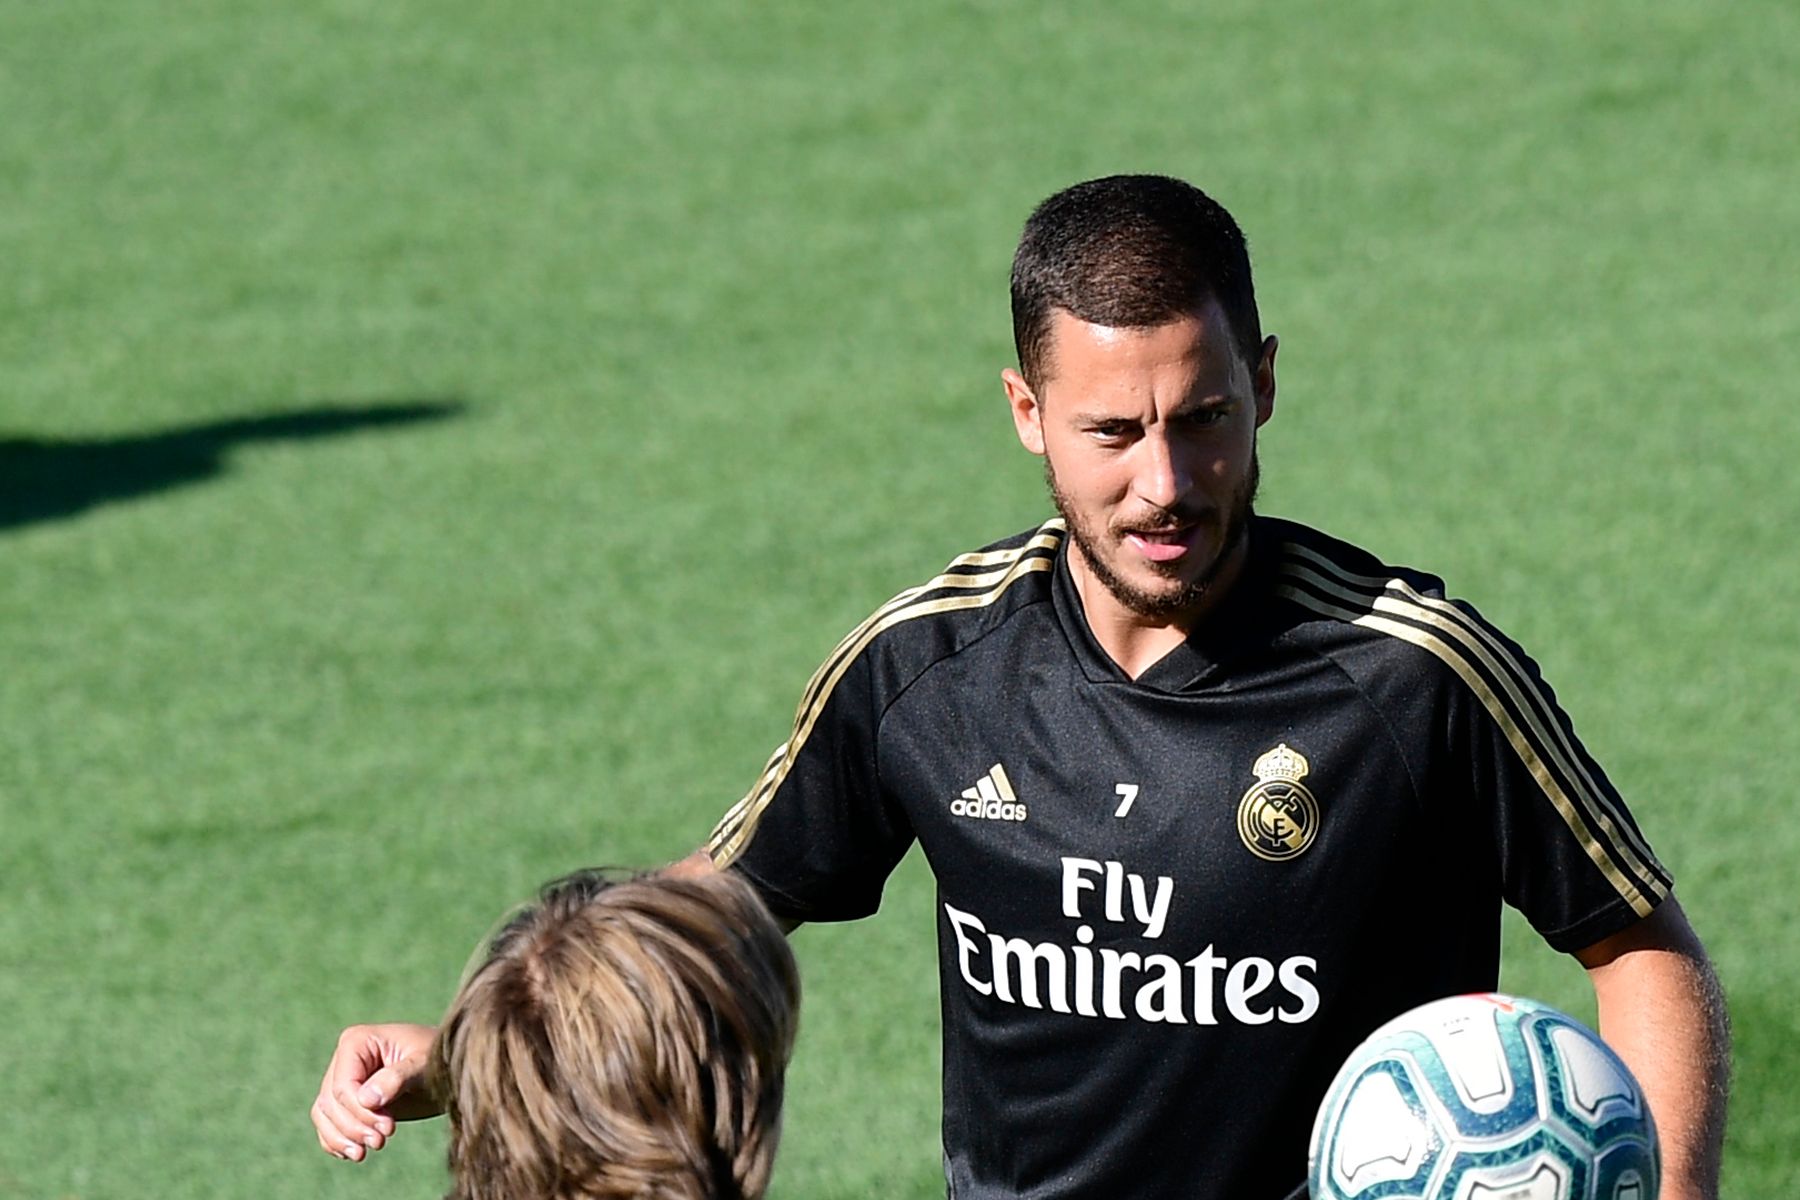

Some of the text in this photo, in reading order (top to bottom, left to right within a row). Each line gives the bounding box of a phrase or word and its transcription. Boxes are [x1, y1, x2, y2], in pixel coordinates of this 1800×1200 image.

[950, 797, 1027, 821] adidas
[1115, 784, 1139, 817] 7
[1061, 857, 1173, 938] Fly
[945, 903, 1320, 1025] Emirates
